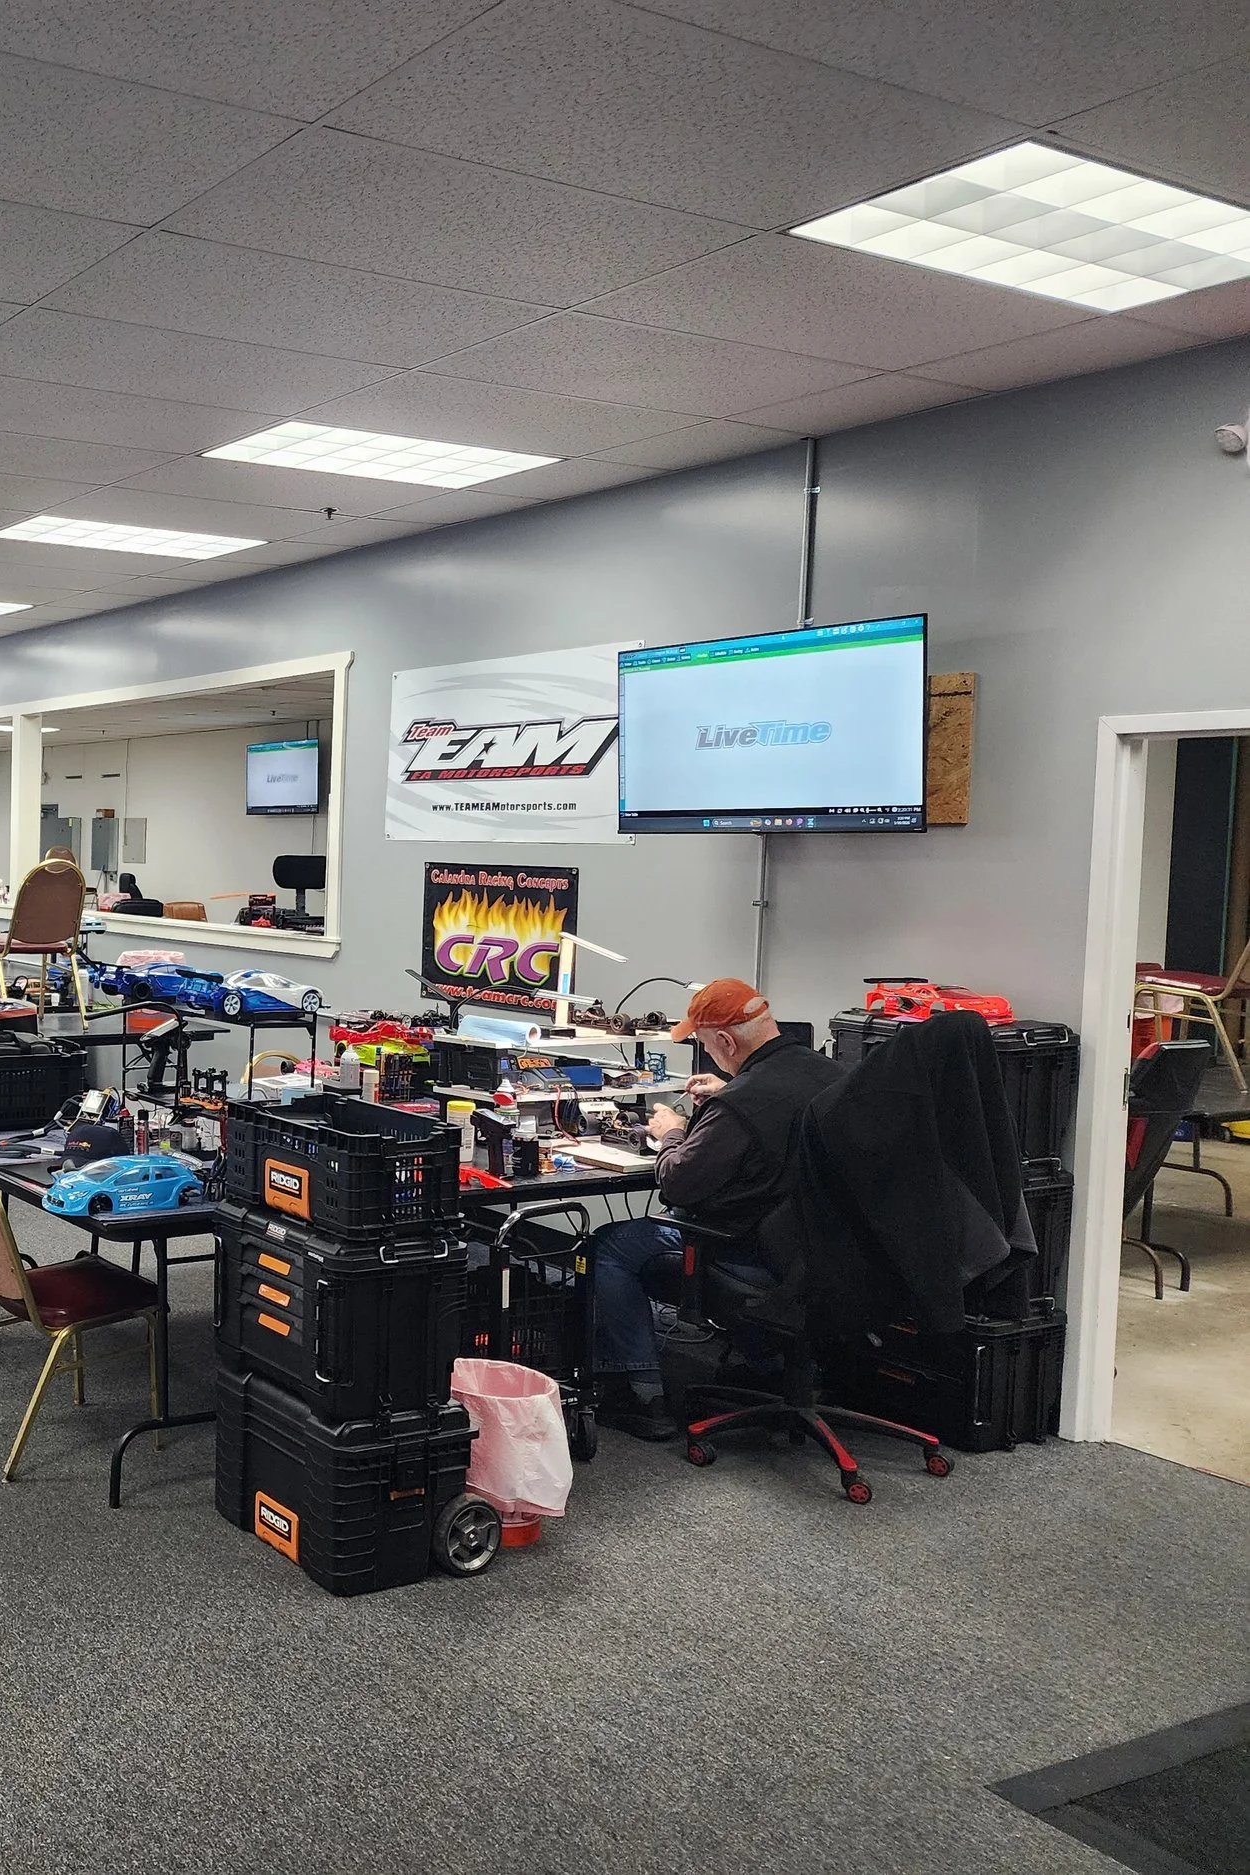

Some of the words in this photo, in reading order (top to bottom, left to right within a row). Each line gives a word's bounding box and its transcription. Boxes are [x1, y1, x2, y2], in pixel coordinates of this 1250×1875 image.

[408, 724, 454, 739] Team
[695, 720, 832, 750] LiveTime
[408, 718, 618, 771] EAM
[410, 772, 431, 780] EA
[438, 764, 588, 780] MOTORSPORTS
[432, 801, 577, 812] www.TEAMEAMotorsports.com
[436, 934, 560, 984] CRC
[427, 983, 557, 1011] www.teamcrc.co
[270, 1171, 300, 1190] RIDGID
[119, 1192, 153, 1202] XRAY
[267, 1223, 287, 1236] RIDGID
[260, 1506, 290, 1532] RIDGID
